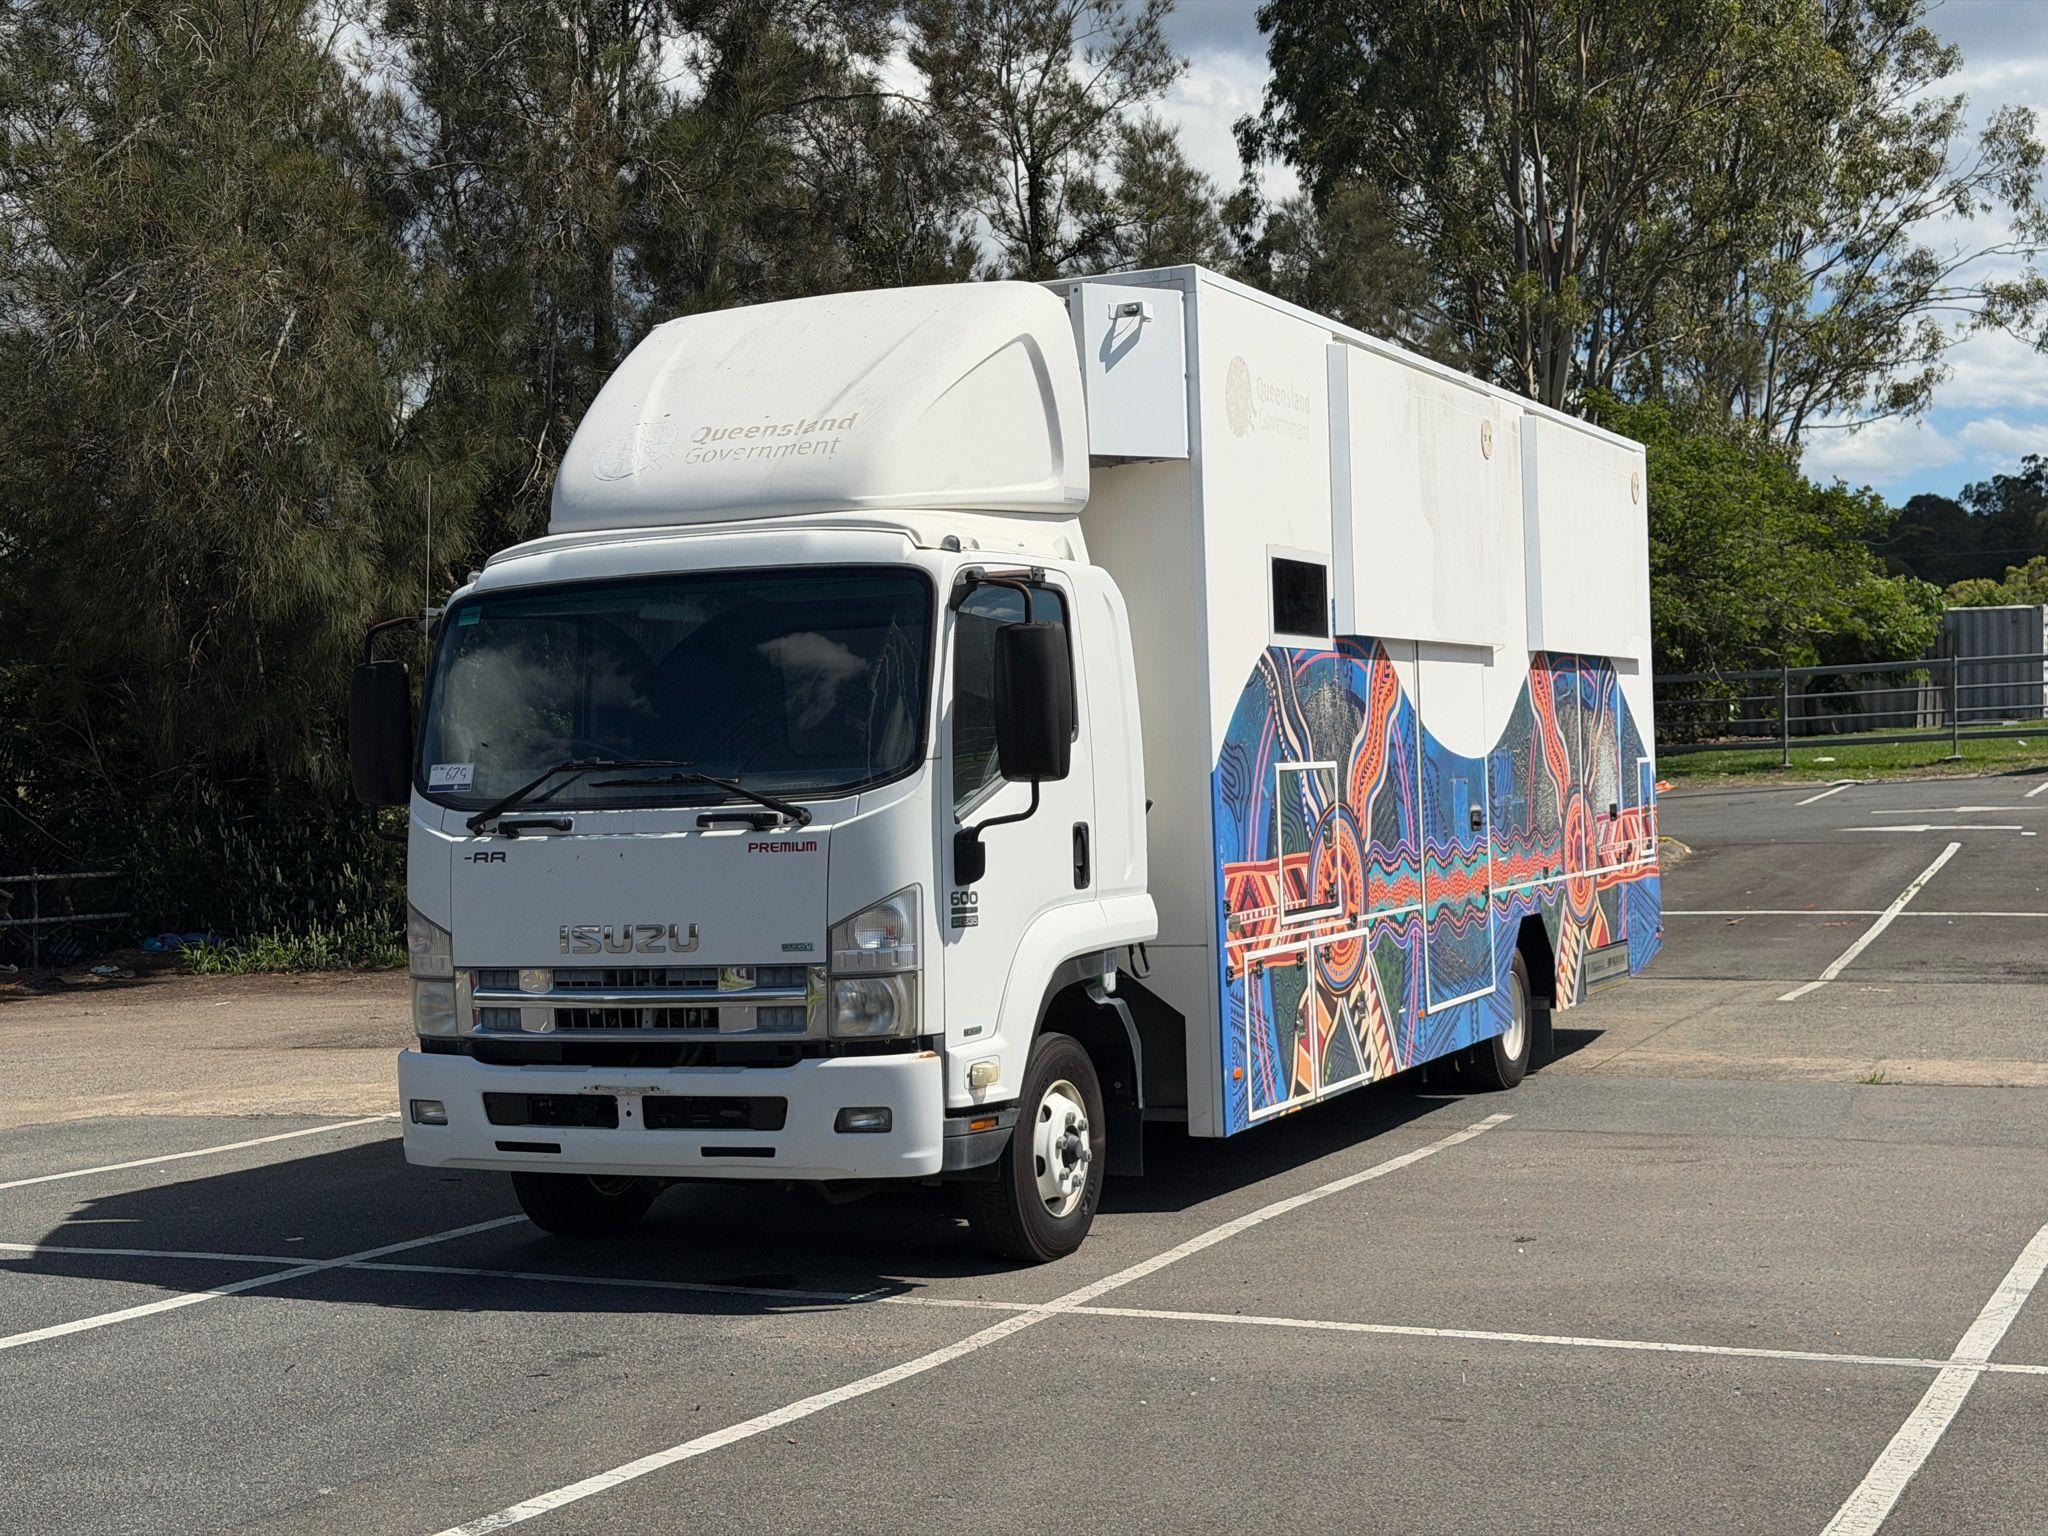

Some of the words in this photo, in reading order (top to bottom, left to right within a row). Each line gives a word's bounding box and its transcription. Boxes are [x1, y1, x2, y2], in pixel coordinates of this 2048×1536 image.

[691, 412, 858, 445] Queensland
[685, 436, 841, 464] Government
[445, 766, 467, 781] 679
[748, 841, 817, 853] PREMIUM
[950, 891, 978, 906] 600
[559, 923, 699, 955] ISUZU
